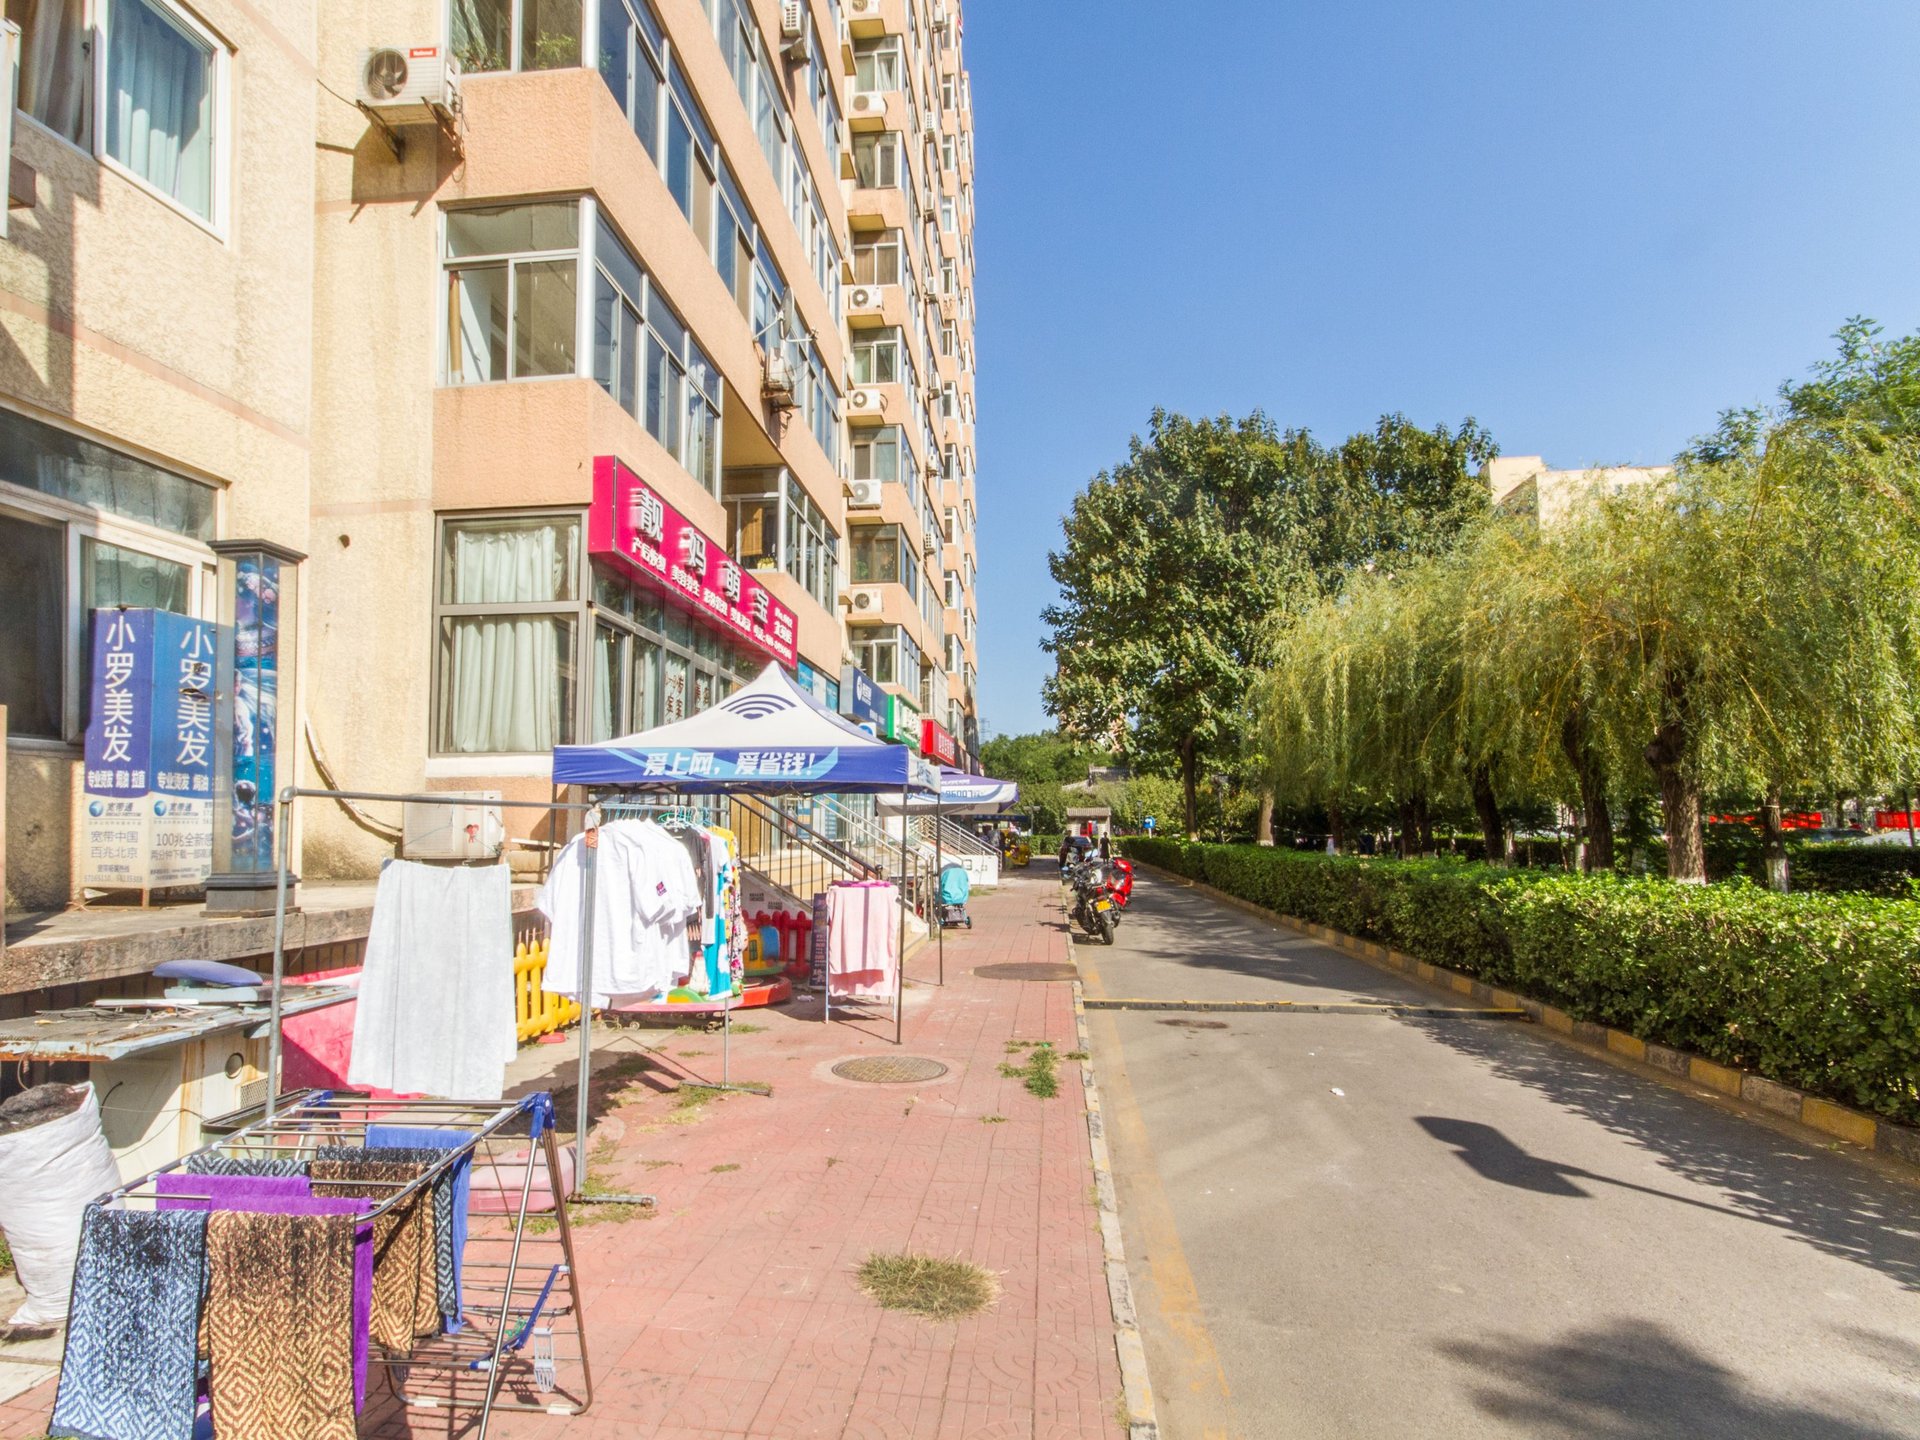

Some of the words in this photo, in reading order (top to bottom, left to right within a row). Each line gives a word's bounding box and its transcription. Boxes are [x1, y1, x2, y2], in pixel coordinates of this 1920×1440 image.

[103, 616, 136, 764] 小罗美发
[91, 831, 139, 843] 宽带中国
[91, 847, 138, 859] 百兆北京
